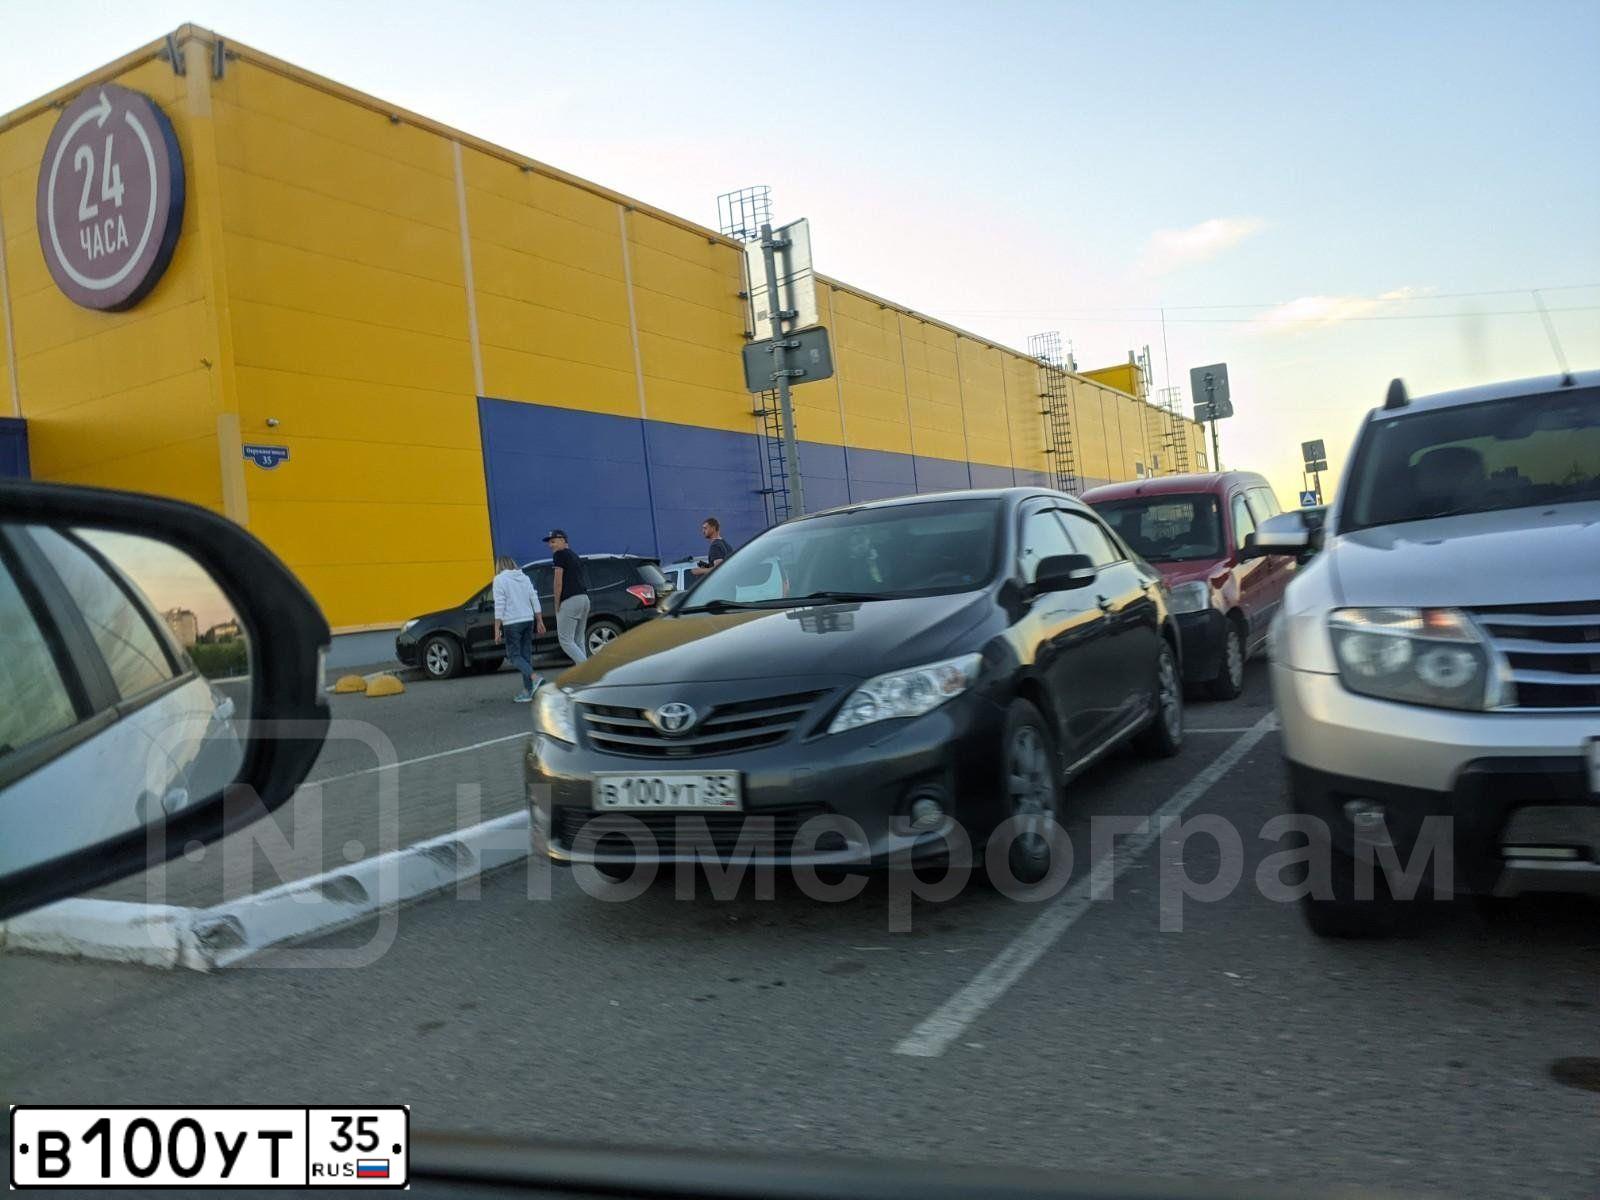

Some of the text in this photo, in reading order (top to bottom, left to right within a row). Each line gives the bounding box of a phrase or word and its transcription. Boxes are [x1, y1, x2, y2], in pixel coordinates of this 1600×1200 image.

[74, 134, 125, 222] 24
[80, 215, 129, 261] ЧАСА
[262, 455, 272, 465] 35
[604, 776, 732, 805] В100УТ 35
